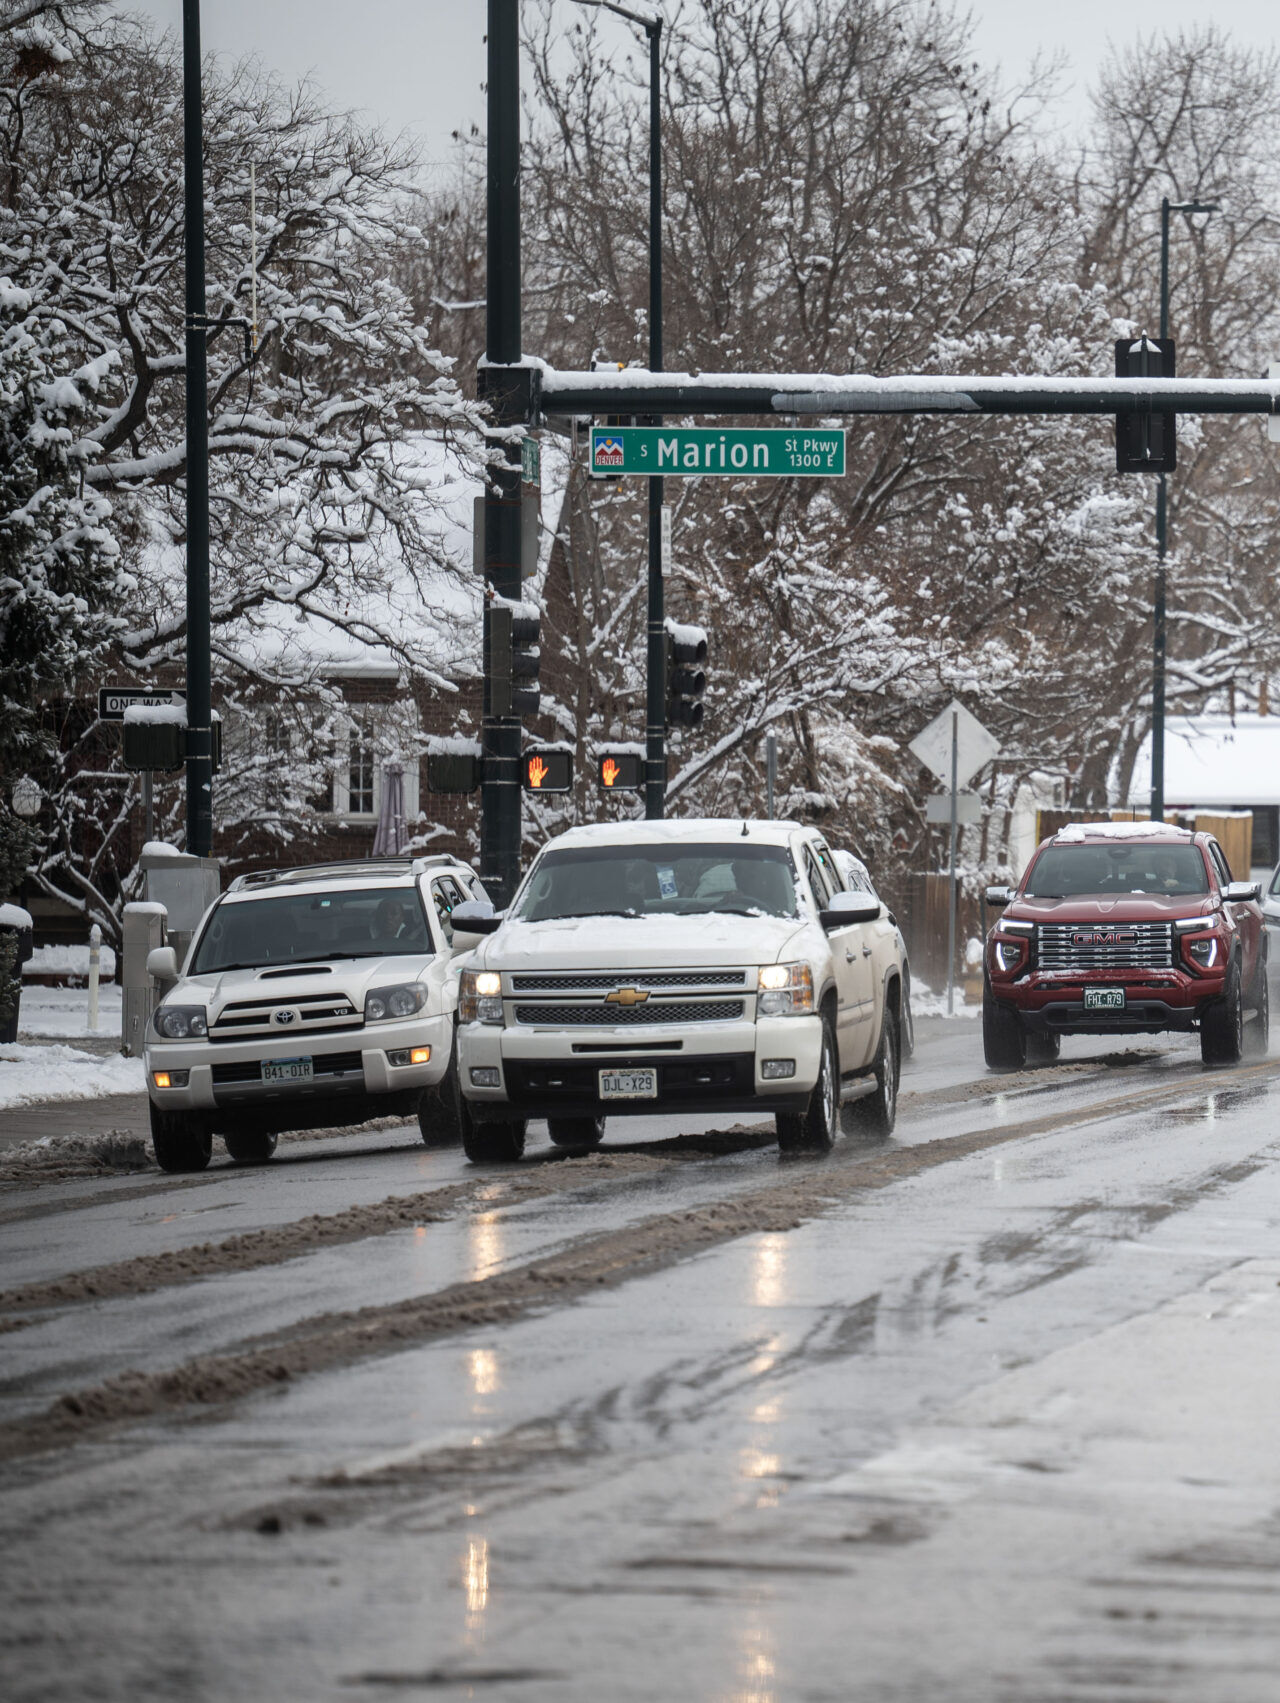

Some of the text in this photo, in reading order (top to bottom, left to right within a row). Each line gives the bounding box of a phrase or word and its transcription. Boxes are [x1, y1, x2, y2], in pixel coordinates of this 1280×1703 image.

[640, 436, 769, 467] S Marion
[785, 439, 838, 456] St Pkwy
[595, 455, 624, 465] DENVER
[790, 455, 834, 467] 1300 E
[1074, 933, 1135, 945] GMC
[333, 1008, 348, 1016] V8
